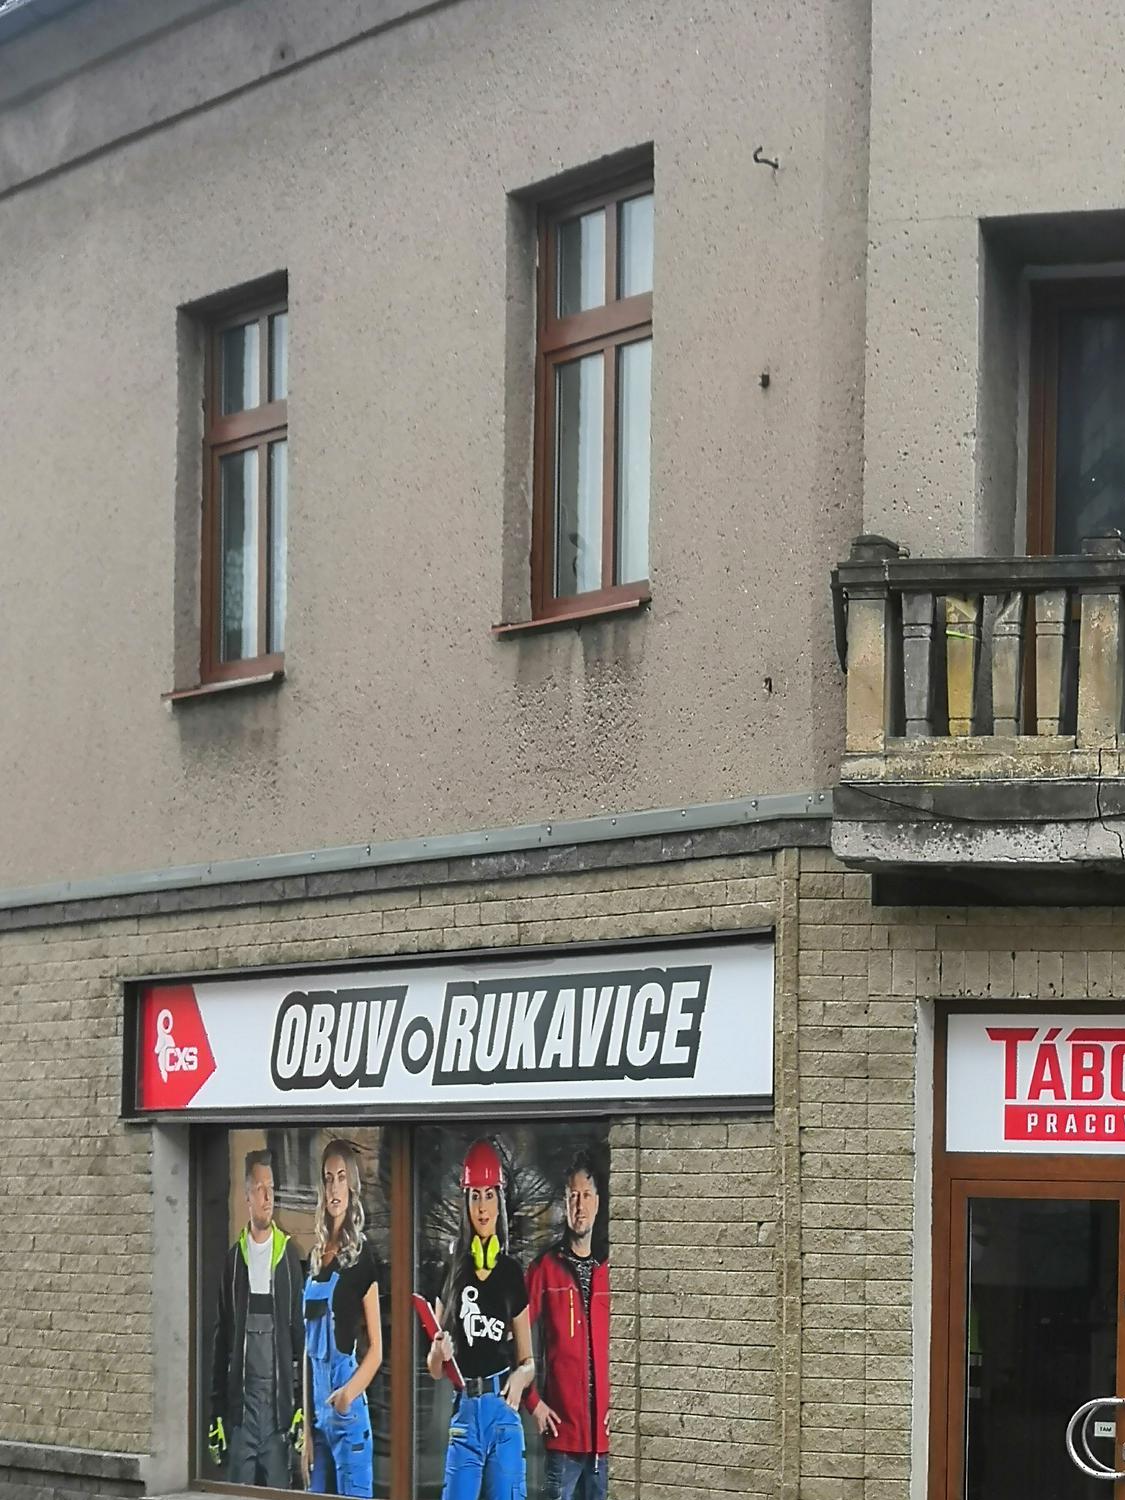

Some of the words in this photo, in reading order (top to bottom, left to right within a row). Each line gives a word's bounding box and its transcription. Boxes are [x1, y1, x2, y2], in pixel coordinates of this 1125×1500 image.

[276, 997, 400, 1080] OBUV
[439, 979, 702, 1074] RUKAVICE
[165, 1046, 199, 1072] CXS
[470, 1314, 505, 1342] CXS
